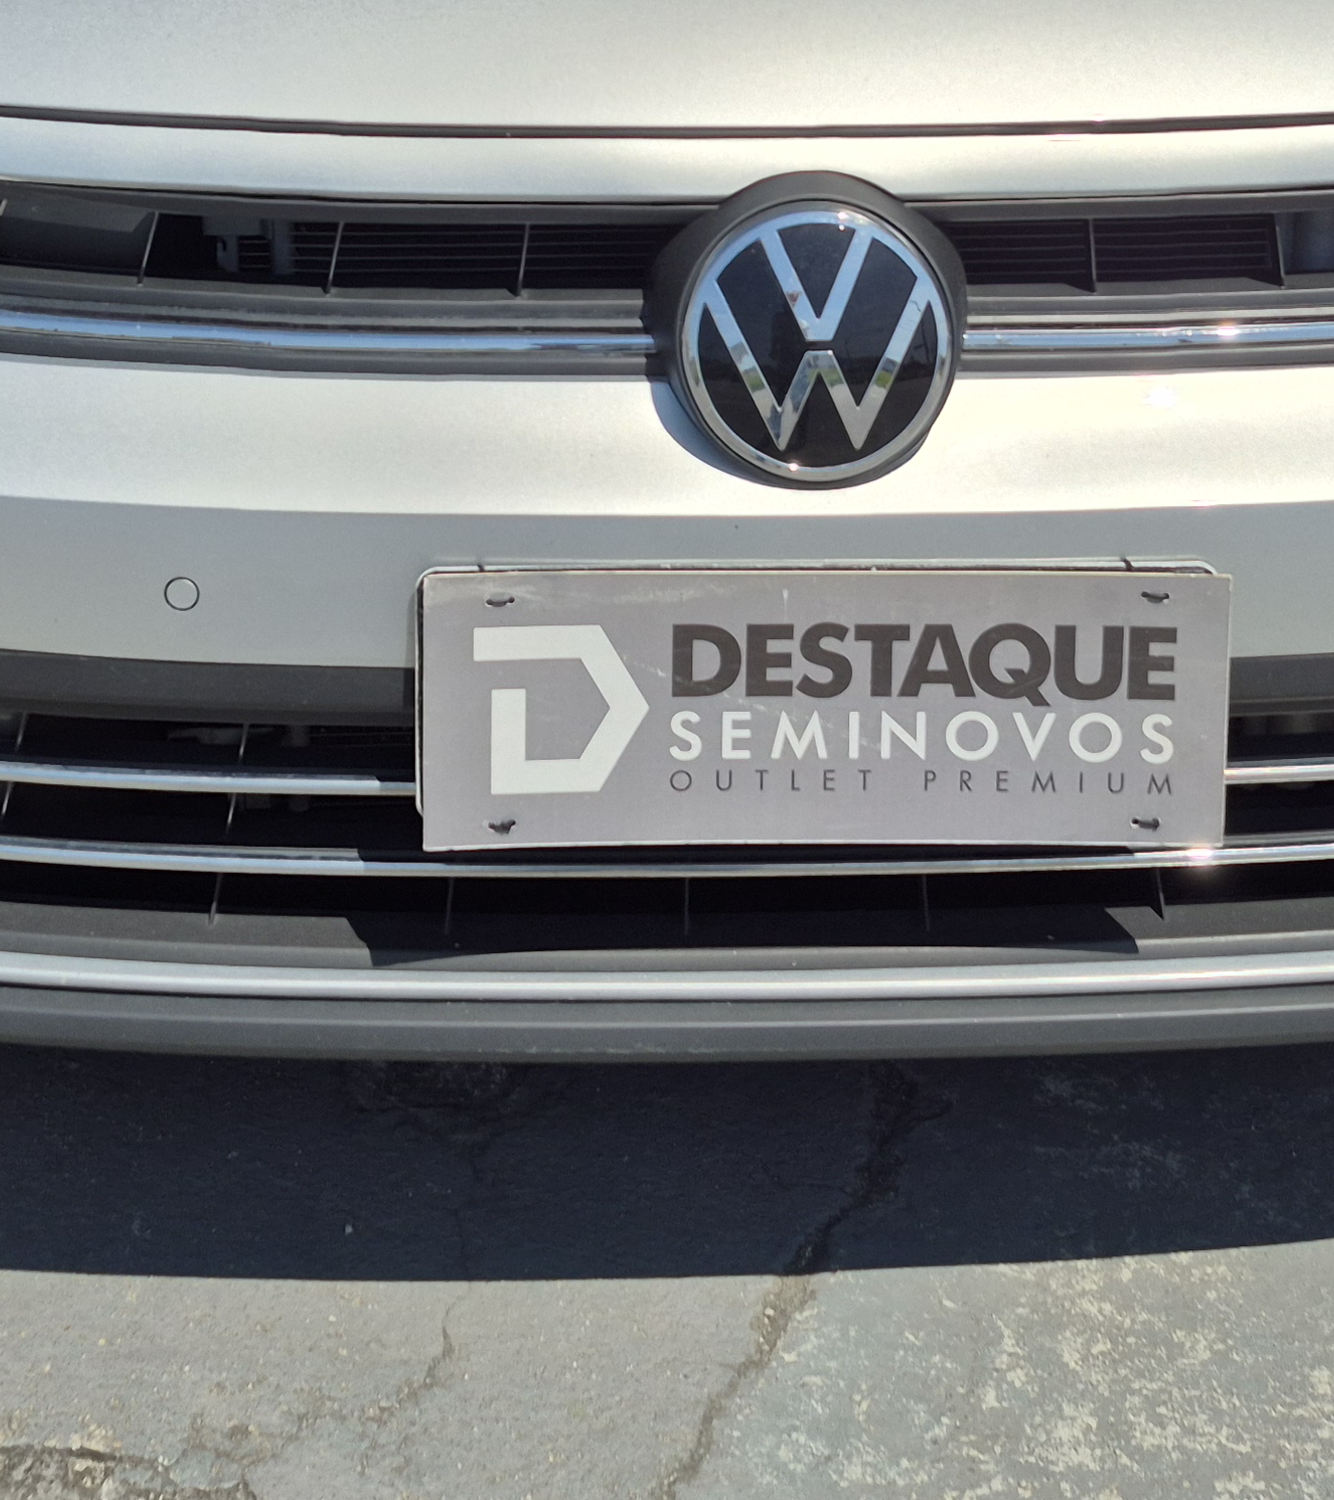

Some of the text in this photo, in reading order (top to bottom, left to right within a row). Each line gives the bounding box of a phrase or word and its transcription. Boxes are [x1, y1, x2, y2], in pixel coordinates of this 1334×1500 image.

[671, 621, 1178, 708] DESTAQUE
[669, 710, 1174, 765] SEMINOVOS
[670, 769, 1173, 796] OUTLET PREMIUM
